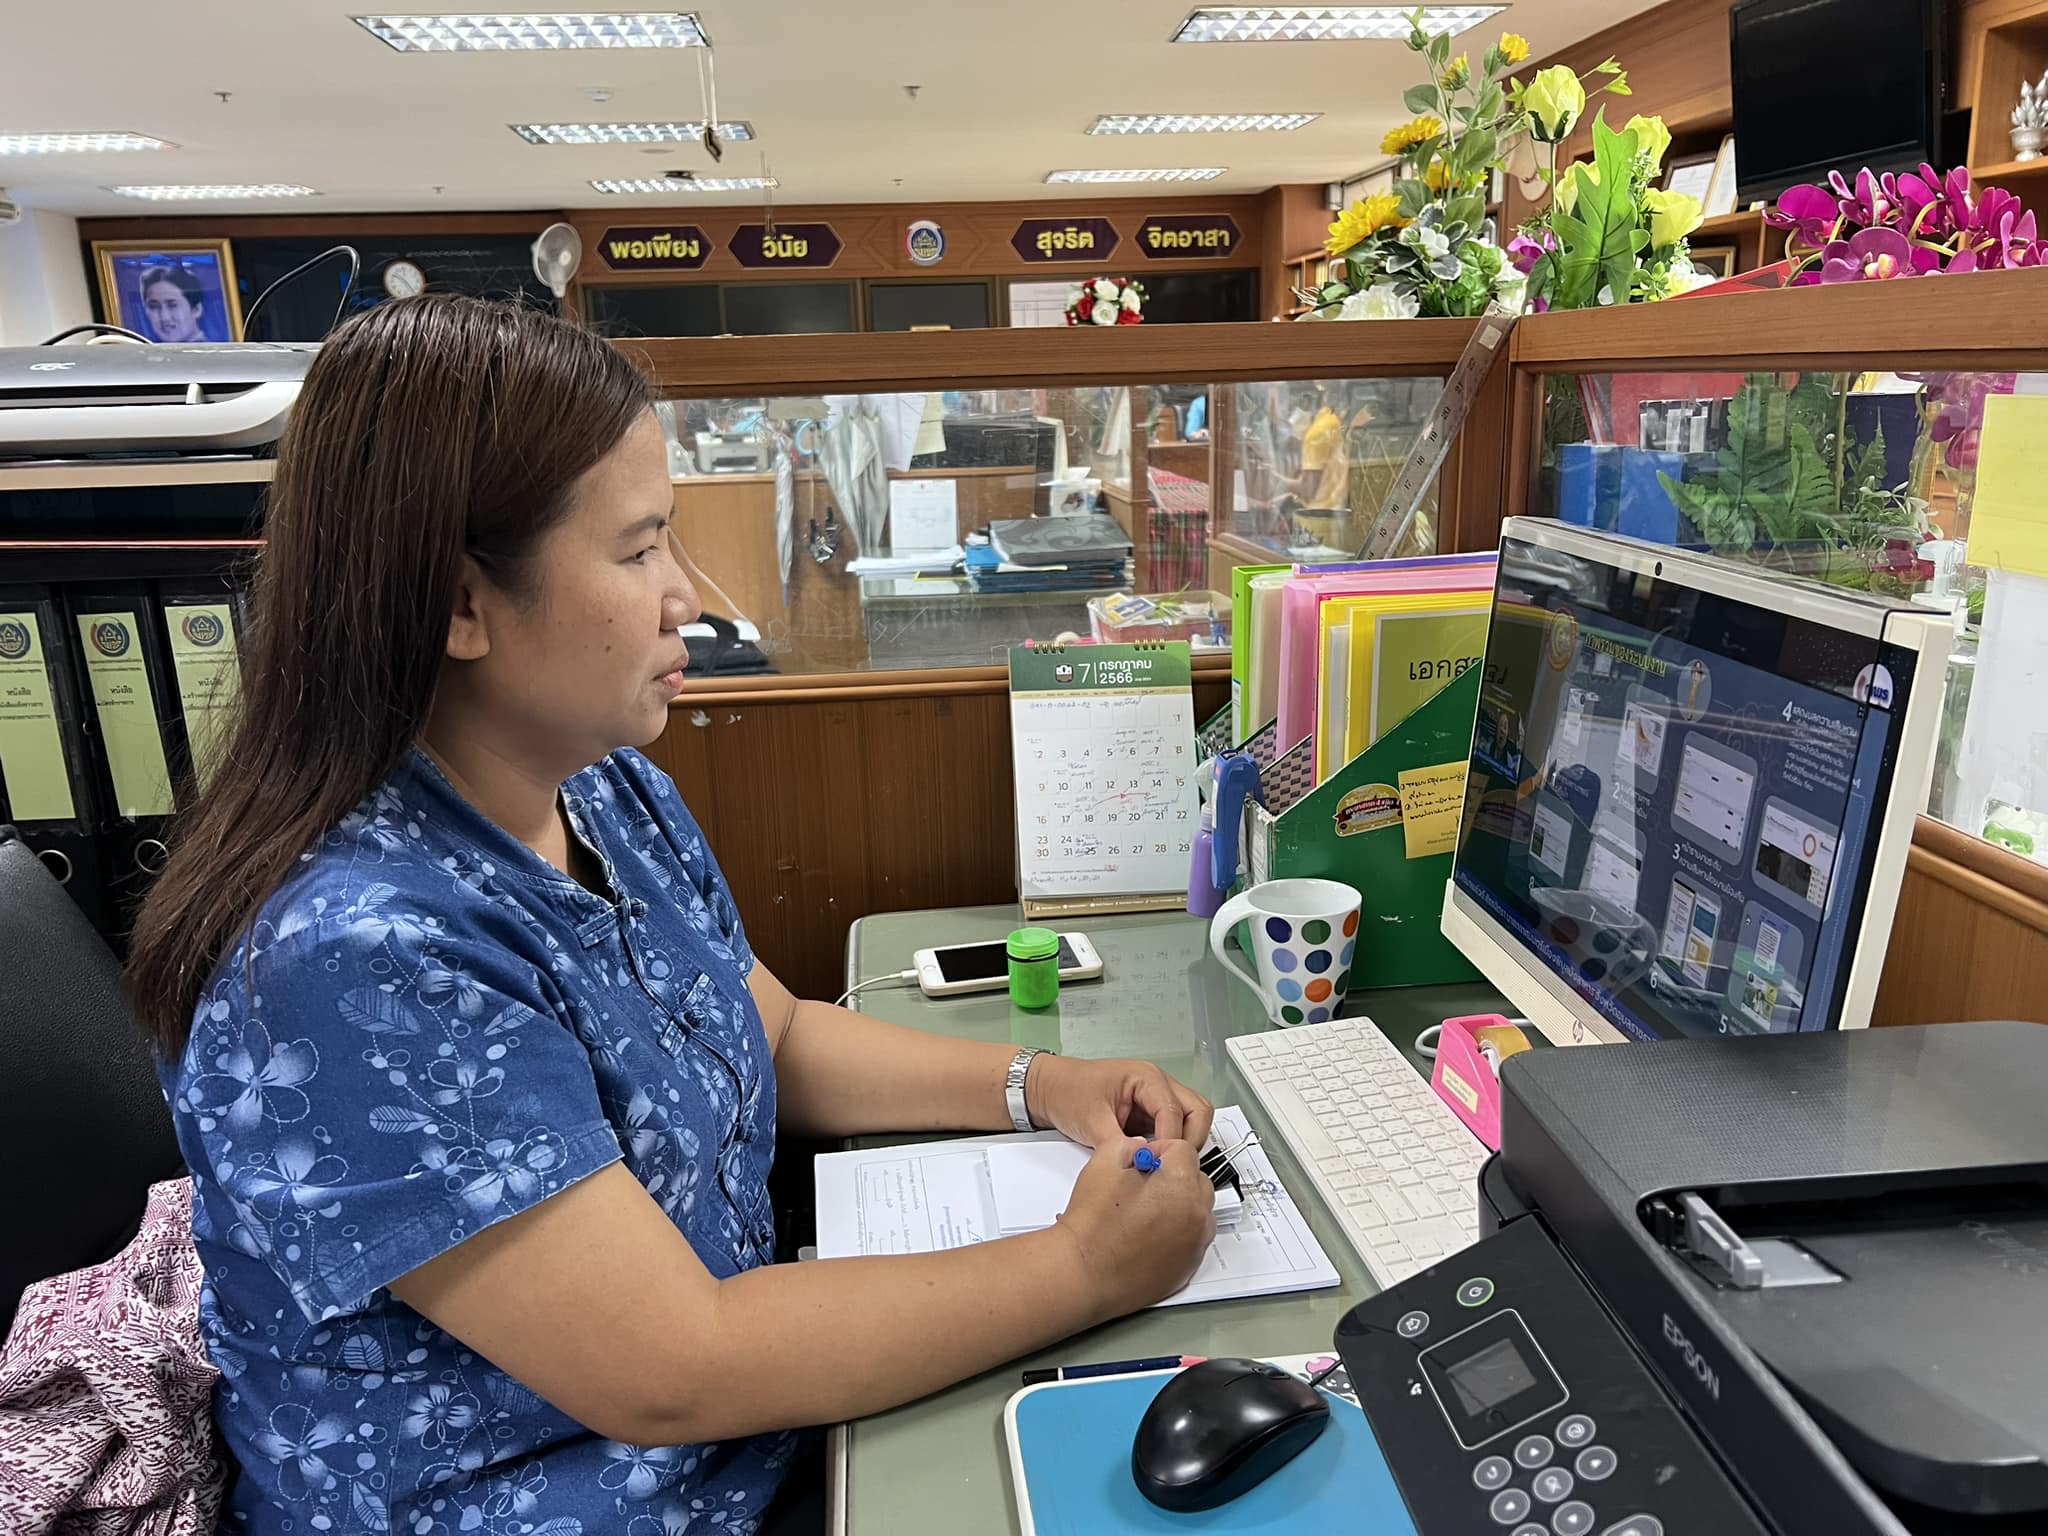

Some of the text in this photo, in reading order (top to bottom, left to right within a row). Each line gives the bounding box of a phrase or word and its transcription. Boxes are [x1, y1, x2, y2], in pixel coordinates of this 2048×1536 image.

[609, 233, 700, 260] พอเพียง
[761, 235, 808, 259] วินัย
[1036, 226, 1094, 253] สุจริต
[1147, 226, 1230, 250] จิตอาสา
[1077, 660, 1152, 683] 7 กรกฎาคม
[1409, 656, 1482, 680] เอกส
[1099, 673, 1133, 684] 2566
[1175, 713, 1181, 721] 1
[1782, 701, 1793, 721] 4
[1036, 745, 1182, 759] 2 3 4 5 6 7 8
[1038, 778, 1185, 792] 9 10 11 12 13 14 15
[1612, 782, 1620, 800] 2
[1036, 810, 1187, 824] 16 17 18 19 20 21 22
[1037, 836, 1049, 845] 23
[1060, 835, 1072, 844] 24
[1036, 848, 1049, 857] 30
[1063, 847, 1073, 856] 31
[1108, 846, 1120, 855] 26
[1132, 845, 1143, 854] 27
[1155, 844, 1167, 853] 28
[1178, 843, 1190, 852] 29
[1672, 843, 1681, 860] 3
[1528, 876, 1535, 890] 8
[1590, 906, 1597, 921] 7
[1650, 971, 1658, 989] 6
[1718, 1015, 1728, 1033] 5
[1663, 1313, 1719, 1398] EPSON
